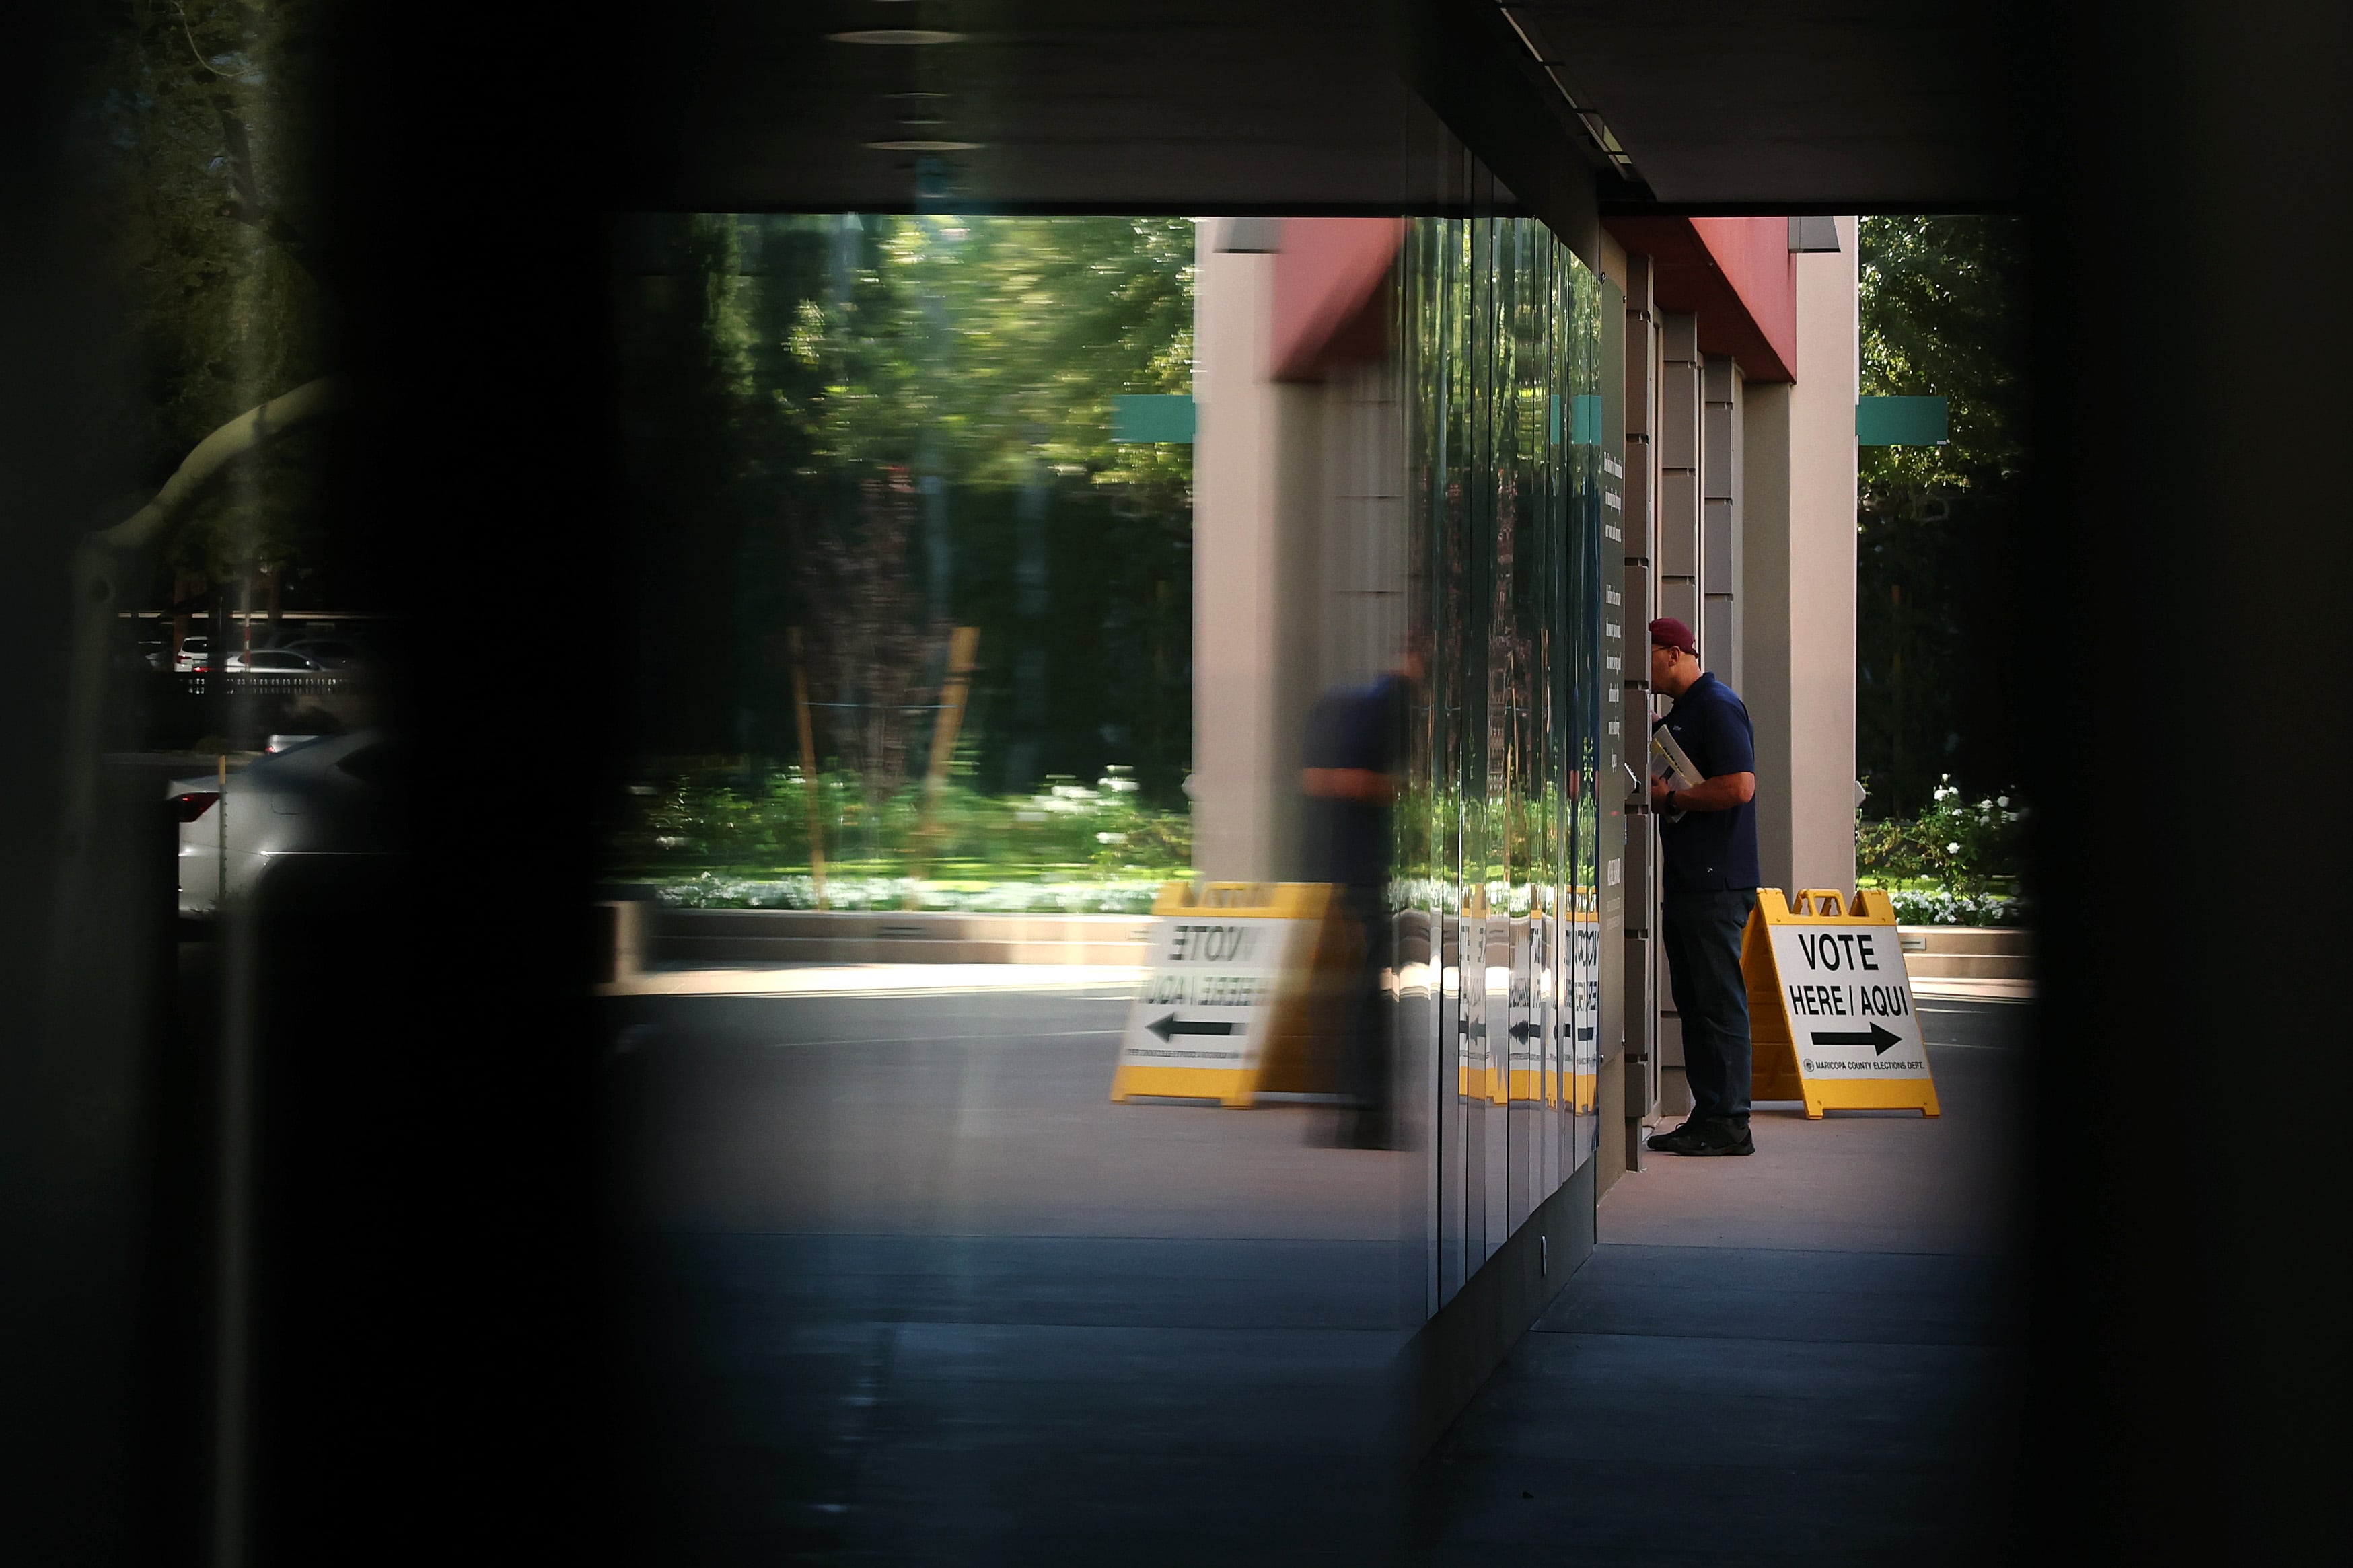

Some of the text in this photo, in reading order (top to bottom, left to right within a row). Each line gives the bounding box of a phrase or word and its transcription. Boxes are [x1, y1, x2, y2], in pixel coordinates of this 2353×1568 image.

[1798, 933, 1879, 971] VOTE
[1789, 985, 1846, 1015] HERE
[1861, 985, 1908, 1017] AQUI
[1816, 1061, 1846, 1070] MARICOPA
[1848, 1061, 1871, 1070] COUNTY
[1873, 1061, 1906, 1070] ELECTIONS
